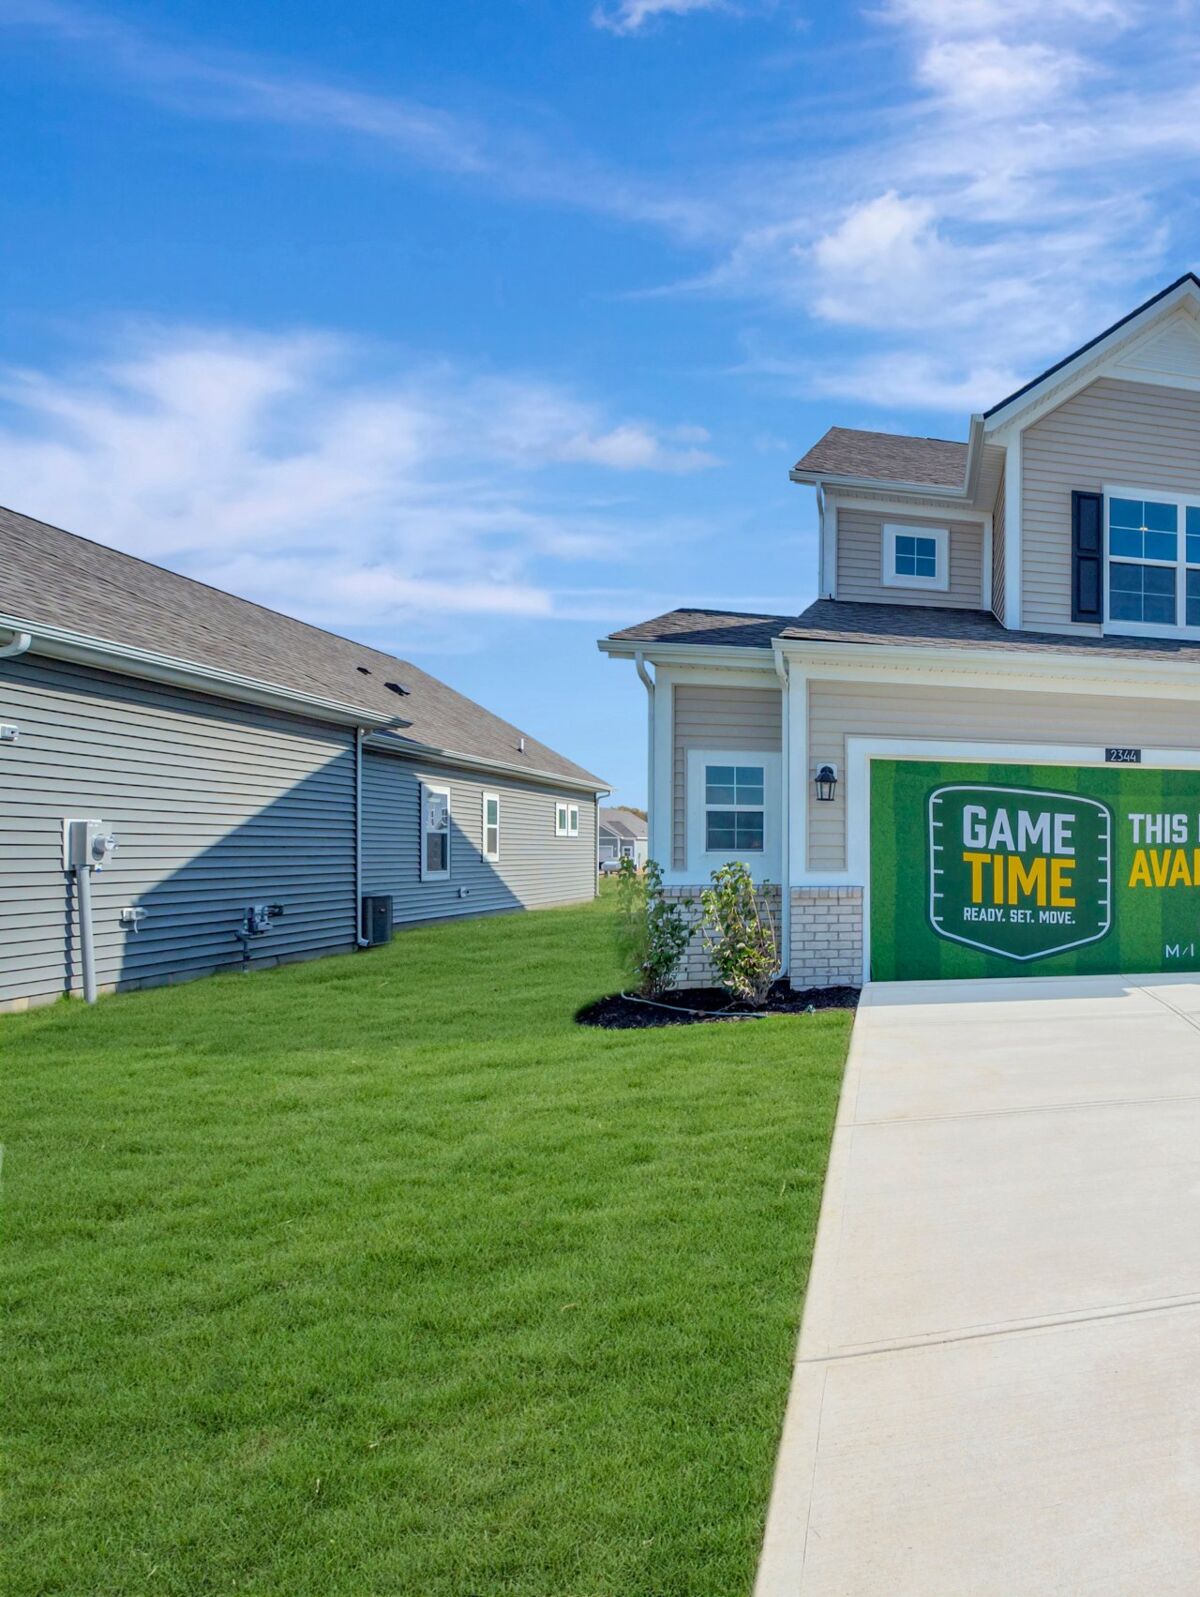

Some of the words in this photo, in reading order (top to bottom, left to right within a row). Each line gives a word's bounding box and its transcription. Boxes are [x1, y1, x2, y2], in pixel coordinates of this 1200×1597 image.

[1110, 749, 1137, 762] 2344
[963, 804, 1076, 855] GAME
[1128, 813, 1188, 844] THIS
[963, 852, 1076, 907] TIME
[963, 907, 1006, 922] READY.
[1010, 910, 1035, 923] SET.
[1039, 911, 1076, 924] MOVE.
[1165, 943, 1194, 958] M/I
